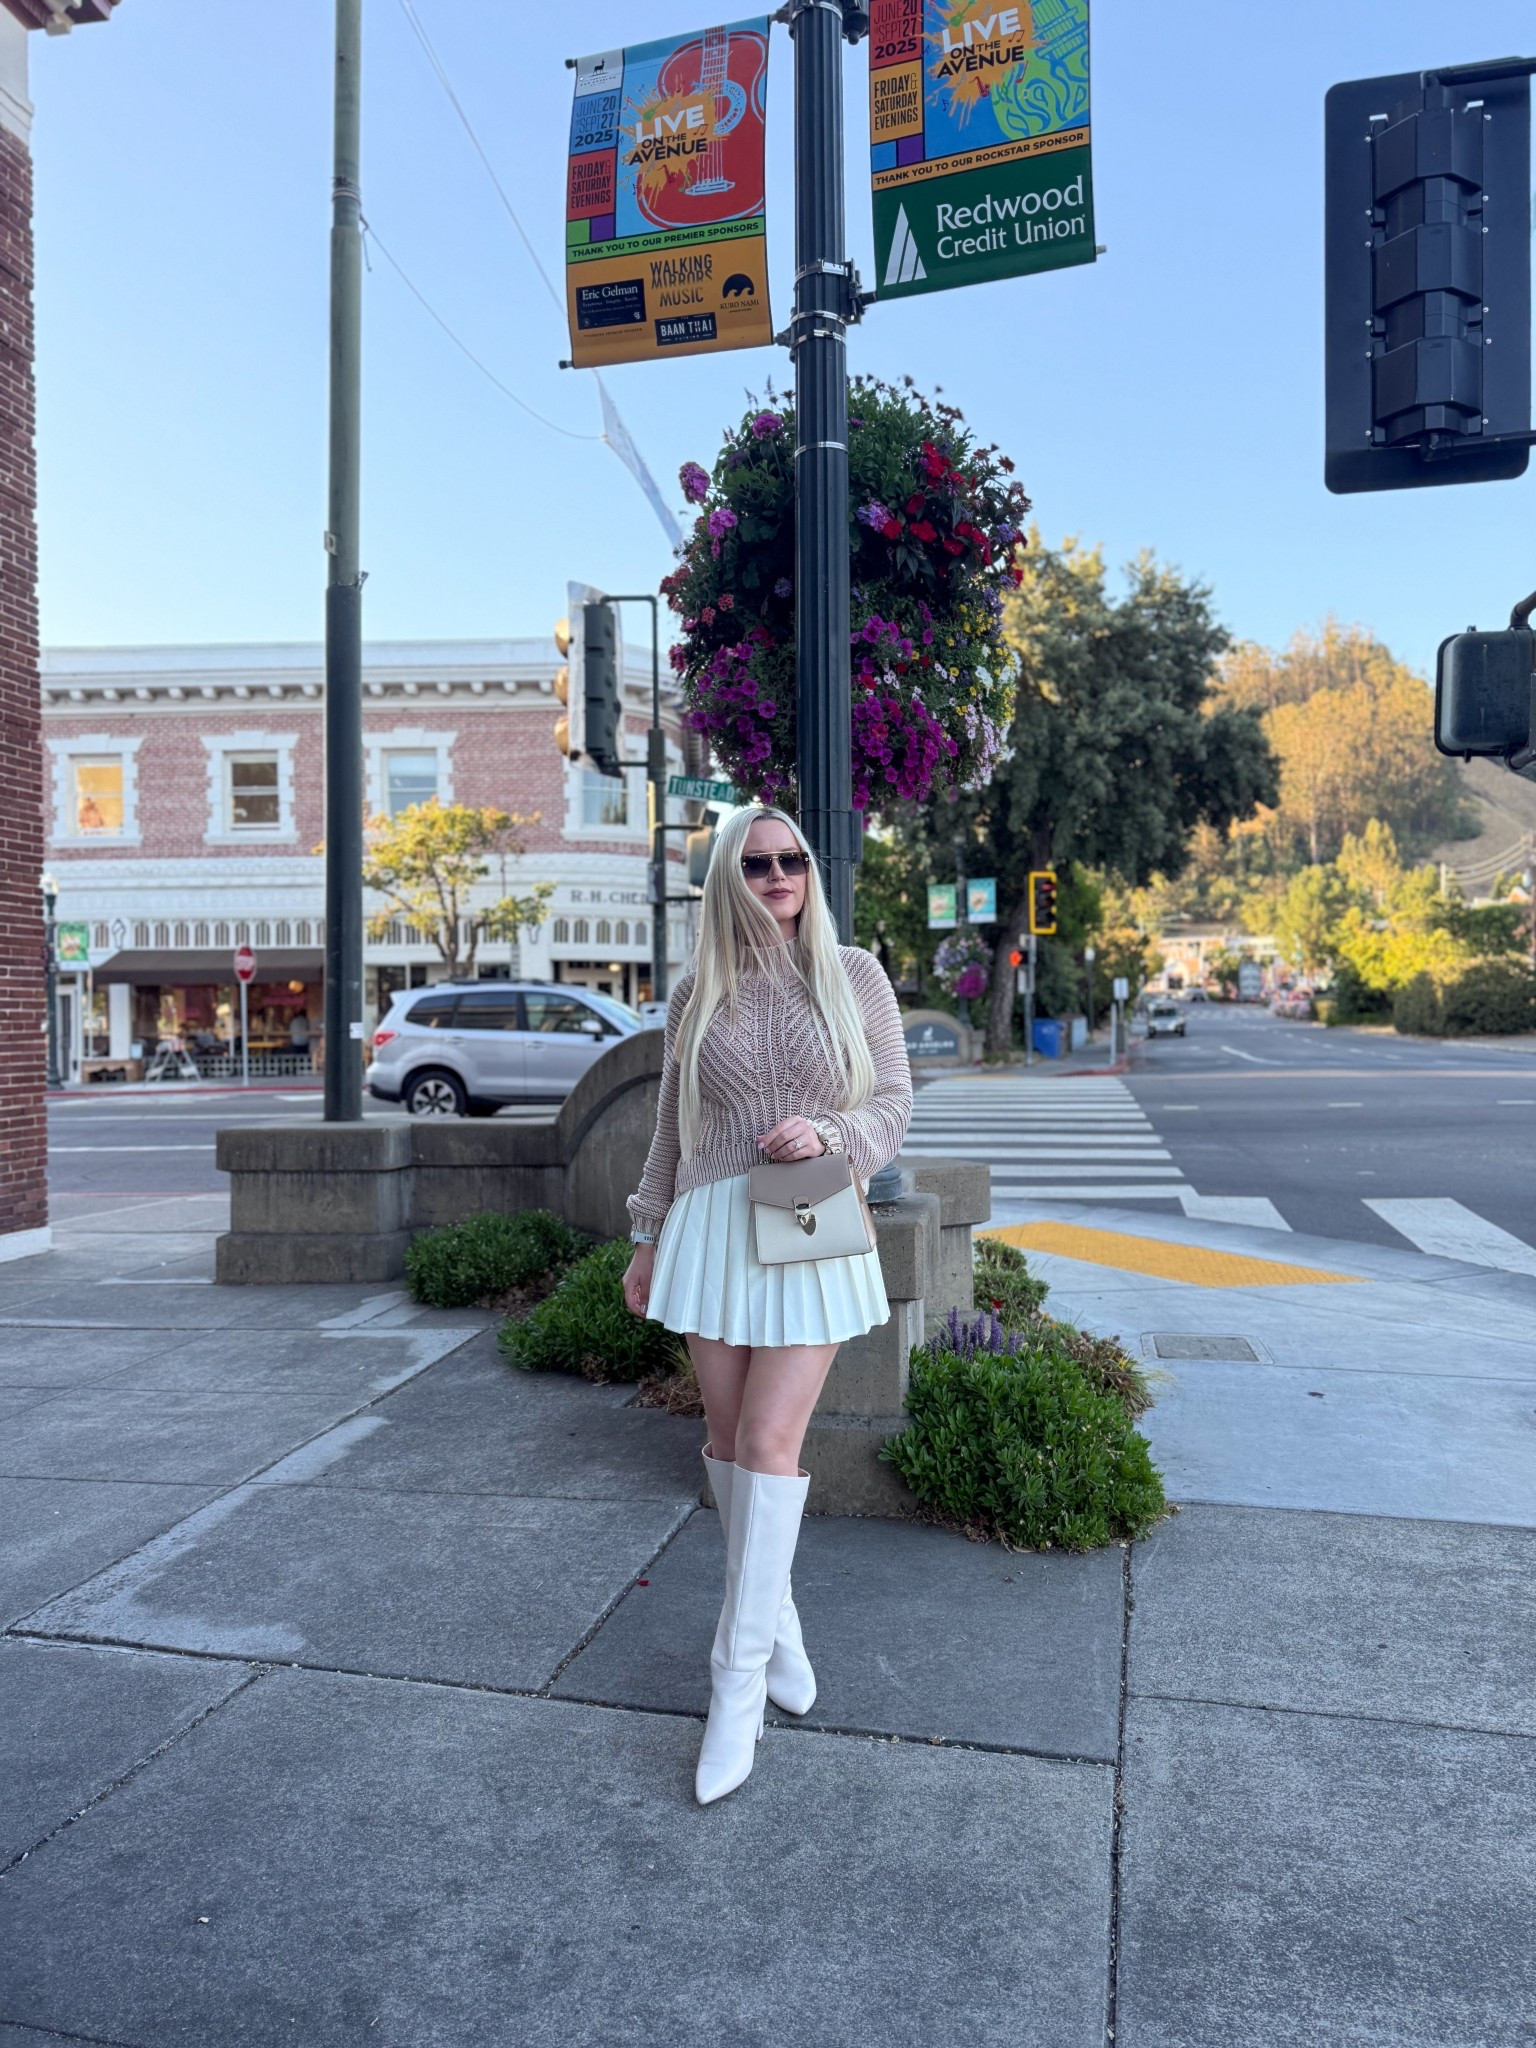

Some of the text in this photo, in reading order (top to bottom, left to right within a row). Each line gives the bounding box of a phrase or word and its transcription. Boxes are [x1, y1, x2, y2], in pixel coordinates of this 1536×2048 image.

[878, 17, 917, 43] SEPT 27
[942, 7, 1020, 53] LIVE
[874, 38, 917, 59] 2025
[950, 40, 1001, 59] ON THE
[937, 45, 1024, 78] AVENUE
[874, 74, 910, 98] FRIDAY
[576, 96, 616, 117] JUNE 20
[874, 91, 918, 114] SATURDAY
[579, 114, 601, 133] SEPT
[601, 113, 615, 129] 27
[636, 105, 704, 143] LIVE
[874, 107, 918, 130] EVENINGS
[574, 130, 613, 148] 2025
[641, 133, 686, 149] ON THE
[629, 138, 707, 166] AVENUE
[876, 132, 1084, 185] THANK YOU TO OUR ROCKSTAR SPONSOR
[572, 161, 605, 180] FRIDAY
[572, 175, 611, 194] SATURDAY
[571, 190, 611, 208] EVENINGS
[936, 174, 1084, 233] Redwood
[572, 222, 759, 257] THANK YOU TO OUR PREMIER SPONSORS
[937, 216, 1085, 259] Credit Union
[650, 253, 713, 274] WALKING
[651, 269, 713, 290] MIRRORS
[582, 284, 638, 301] Eric Gelman
[659, 287, 704, 308] MUSIC
[720, 299, 759, 310] KURO NAMI
[660, 319, 713, 337] BAAN THAI
[671, 778, 735, 800] TUNSTEAD
